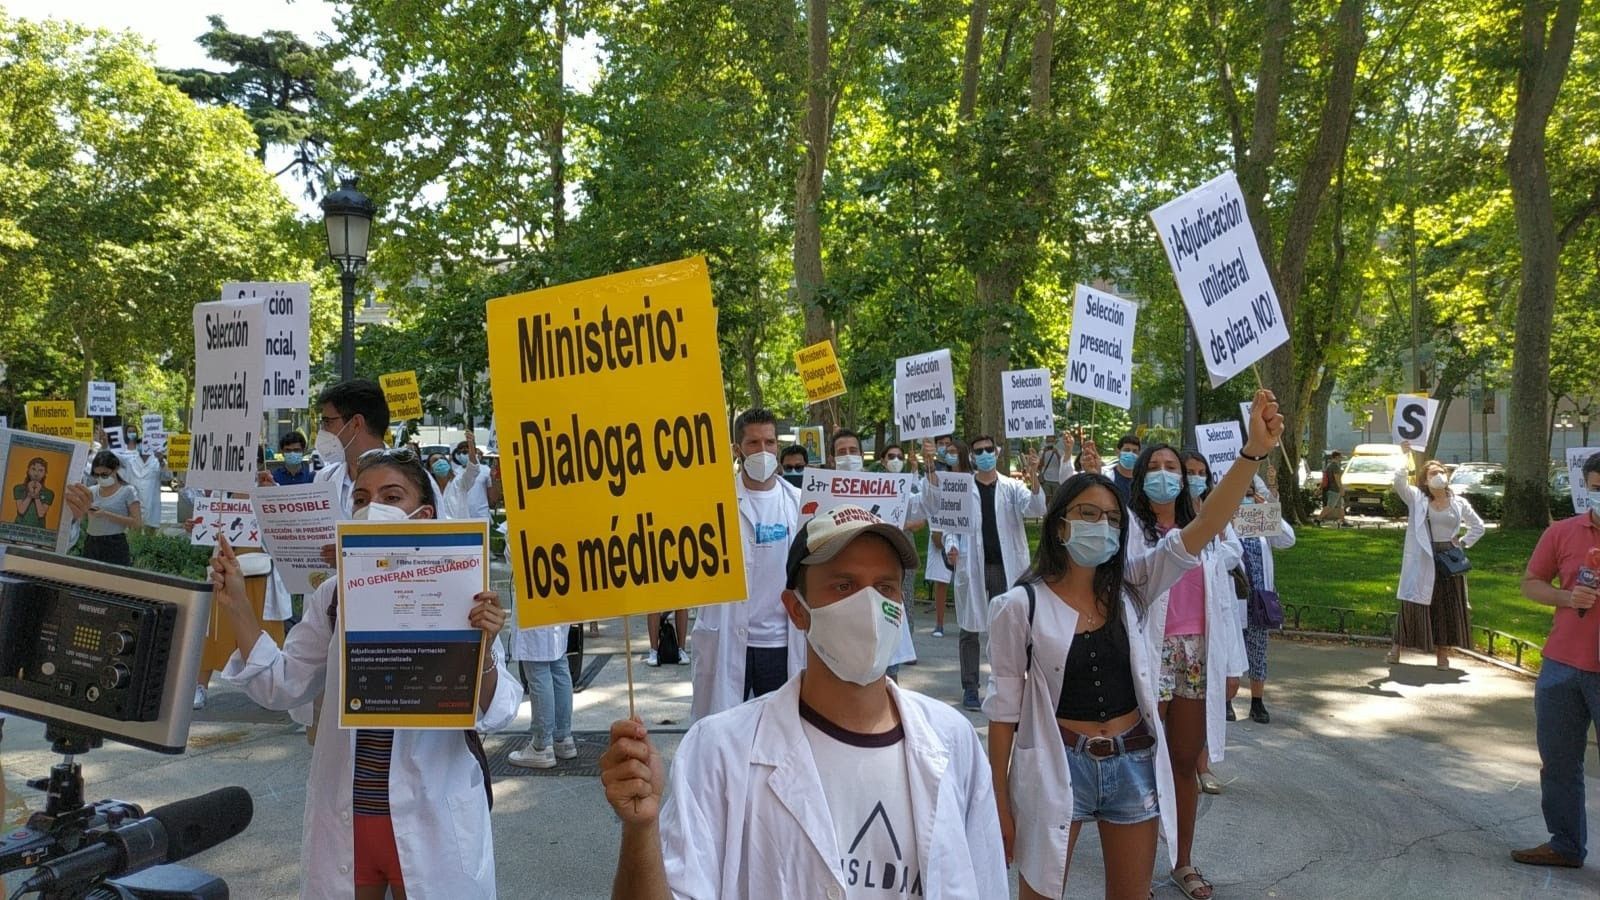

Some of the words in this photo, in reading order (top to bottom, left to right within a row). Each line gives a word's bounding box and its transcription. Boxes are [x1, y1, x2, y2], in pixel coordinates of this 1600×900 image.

[1169, 192, 1243, 272] ¡Adjudicación
[1199, 247, 1250, 307] unilateral
[1086, 294, 1124, 327] Selección
[205, 310, 249, 351] Selección
[517, 295, 688, 384] Ministerio:
[1210, 329, 1227, 365] de
[1225, 315, 1260, 364] plaza,
[1251, 291, 1277, 334] NO!
[265, 331, 296, 361] ncial,
[1080, 333, 1124, 365] presencial,
[825, 363, 837, 374] con
[905, 356, 940, 378] Selección
[1011, 373, 1042, 389] Selección
[1070, 359, 1088, 384] NO
[1090, 363, 1105, 390] "on
[1107, 369, 1128, 396] line".
[201, 371, 249, 422] presencial,
[408, 391, 418, 400] con
[905, 381, 946, 410] presencial,
[1011, 394, 1046, 414] presencial,
[33, 405, 69, 418] Ministerio:
[902, 414, 916, 432] NO
[916, 412, 931, 429] "on
[932, 407, 953, 427] line".
[1008, 417, 1020, 432] NO
[1021, 416, 1033, 431] "on
[1397, 403, 1426, 440] S
[60, 426, 72, 436] con
[106, 431, 122, 449] E
[1206, 426, 1234, 442] Selección
[191, 433, 208, 471] NO
[209, 431, 222, 472] "on
[224, 431, 251, 473] line".
[512, 413, 646, 510] ¡Dialoga
[654, 411, 717, 472] con
[942, 479, 968, 493] dicación
[261, 503, 277, 514] ES
[278, 500, 331, 513] POSIBLE
[930, 515, 939, 524] de
[939, 515, 957, 528] plaza,
[520, 530, 570, 600] los
[577, 502, 730, 593] médicos!
[347, 577, 365, 591] ¡NO
[367, 569, 414, 586] GENERAN
[416, 558, 480, 577] RESGUARDO!
[351, 647, 386, 655] Adjudicación
